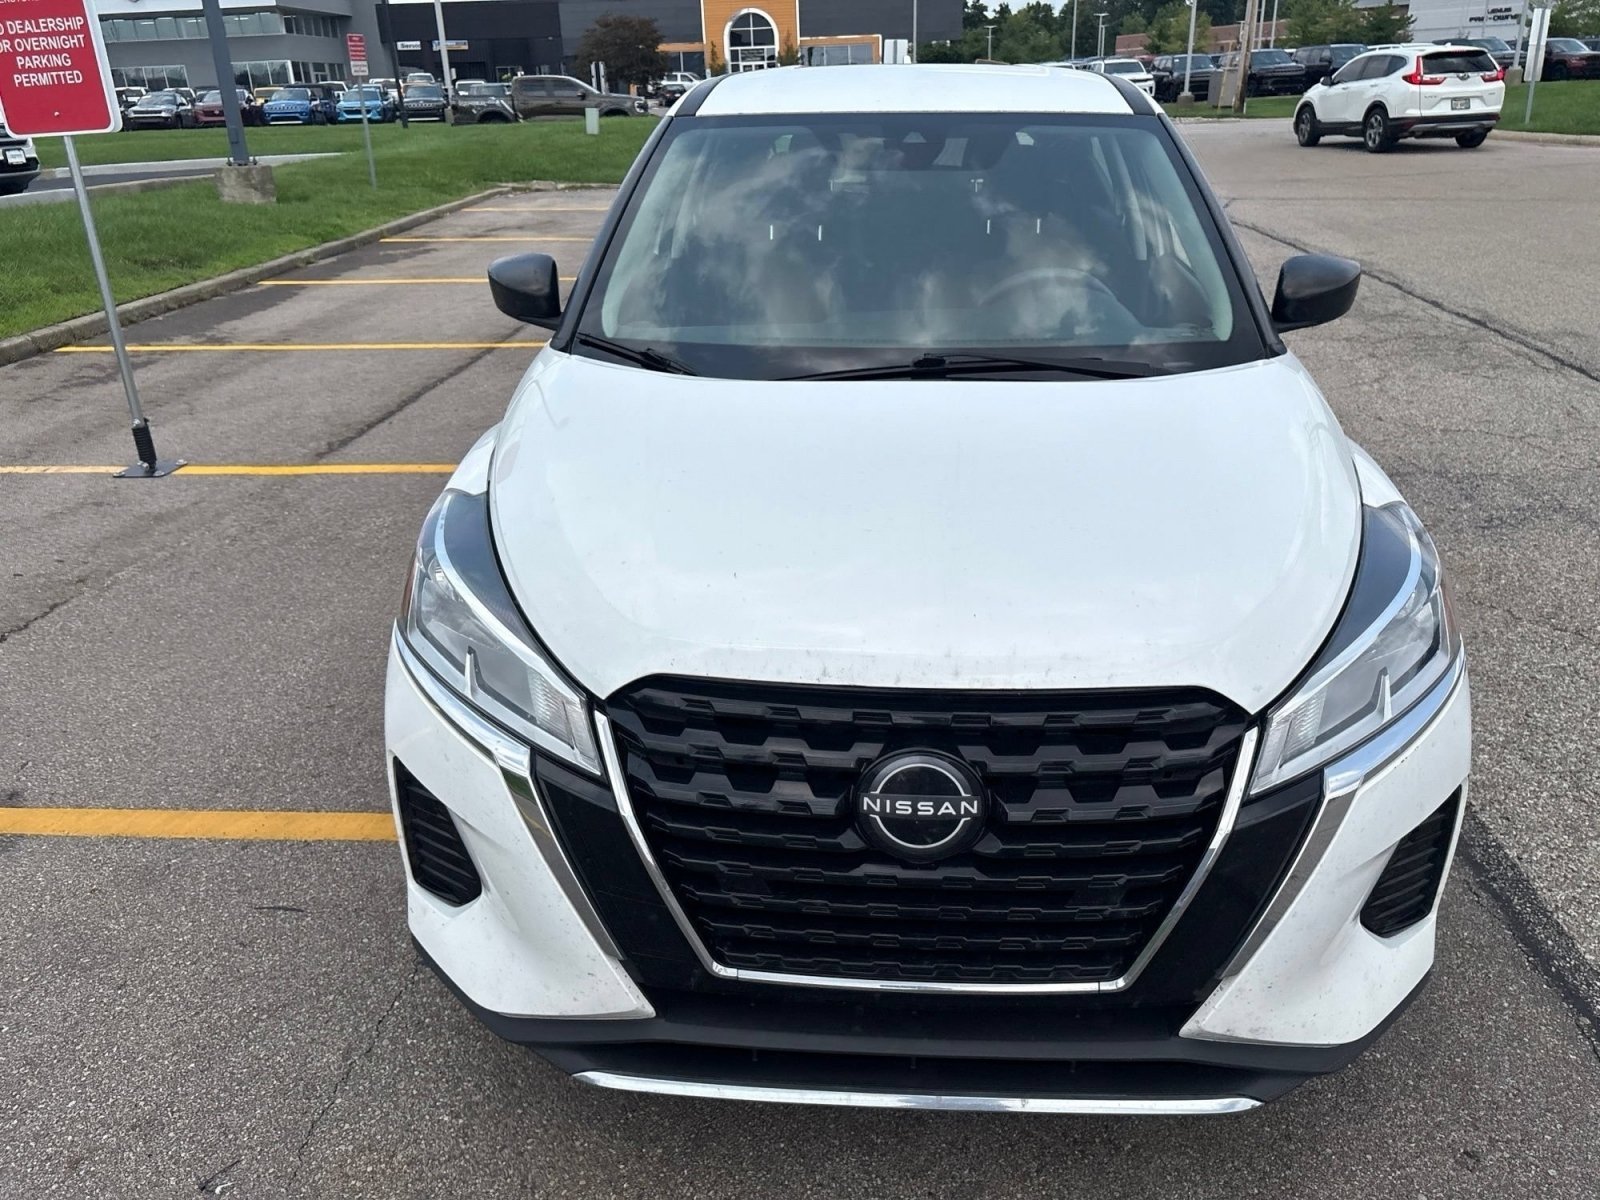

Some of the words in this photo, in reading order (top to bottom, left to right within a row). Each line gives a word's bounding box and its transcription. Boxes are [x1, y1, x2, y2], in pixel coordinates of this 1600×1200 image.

[6, 16, 84, 35] DEALERSHIP
[14, 34, 85, 52] OVERNIGHT
[16, 53, 71, 69] PARKING
[13, 70, 82, 87] PERMITTED
[863, 796, 978, 816] NISSAN
